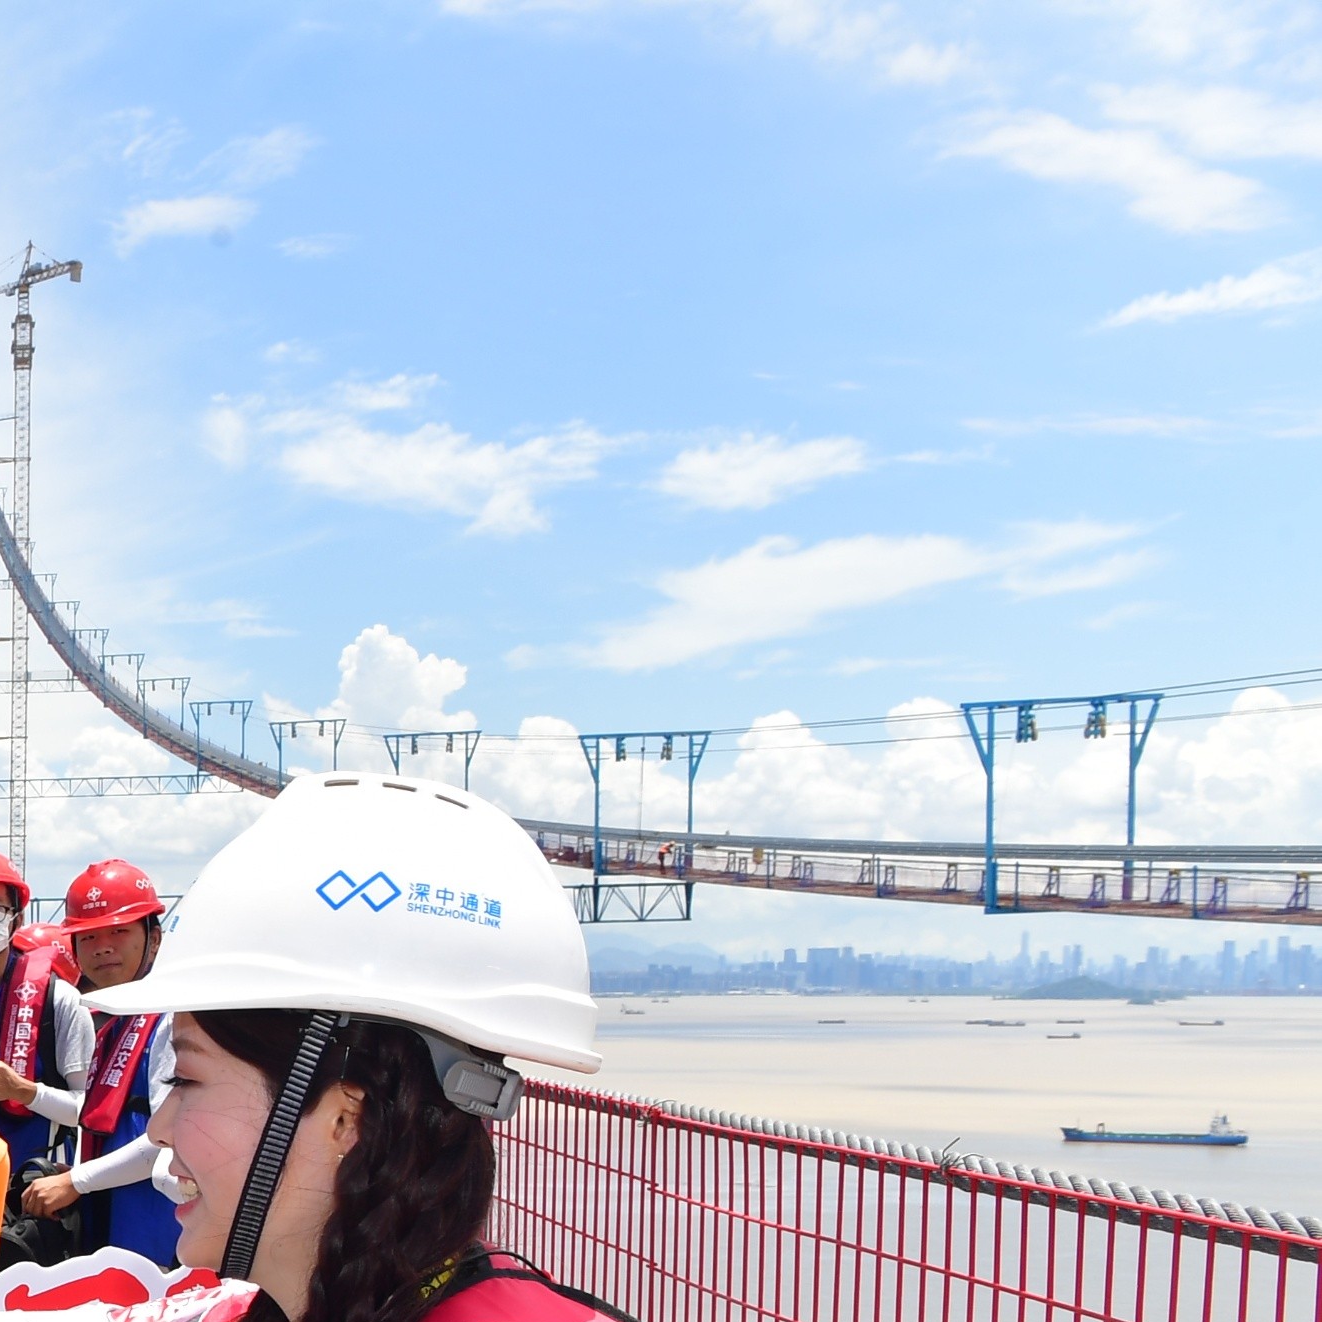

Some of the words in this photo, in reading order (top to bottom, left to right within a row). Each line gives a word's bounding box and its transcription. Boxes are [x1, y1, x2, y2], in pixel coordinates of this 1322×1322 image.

[406, 902, 476, 923] SHENZHONG
[478, 915, 502, 930] LINK
[407, 882, 502, 919] 深中通道
[11, 1004, 34, 1077] 中国交建
[105, 1014, 147, 1088] 中国交建
